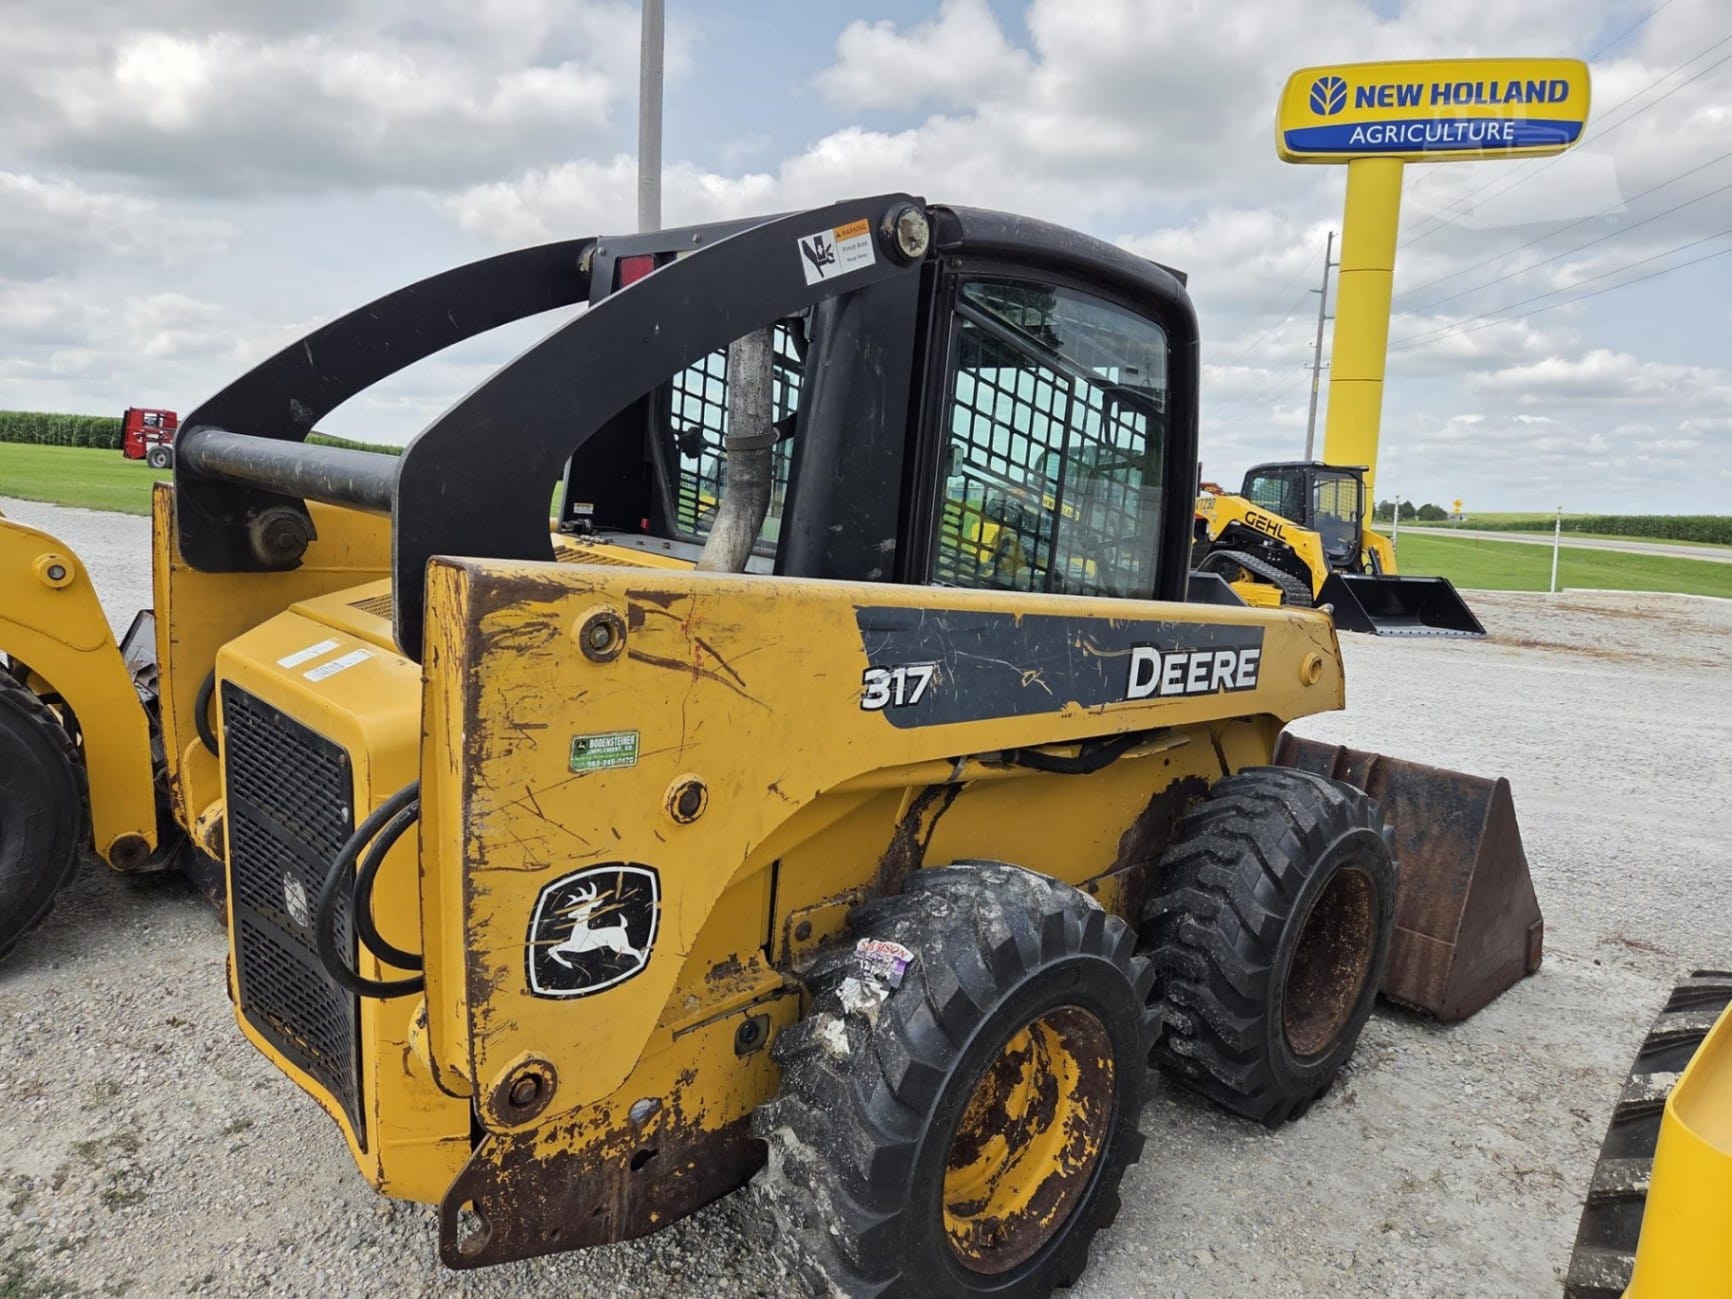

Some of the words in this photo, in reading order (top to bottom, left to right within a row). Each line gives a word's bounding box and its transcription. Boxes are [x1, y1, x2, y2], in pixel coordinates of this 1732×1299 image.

[1355, 84, 1424, 109] NEW
[1430, 79, 1569, 106] HOLLAND
[1349, 121, 1515, 144] AGRICULTURE
[1245, 511, 1287, 541] GEHL
[861, 663, 933, 710] 317
[1127, 646, 1261, 699] DEERE
